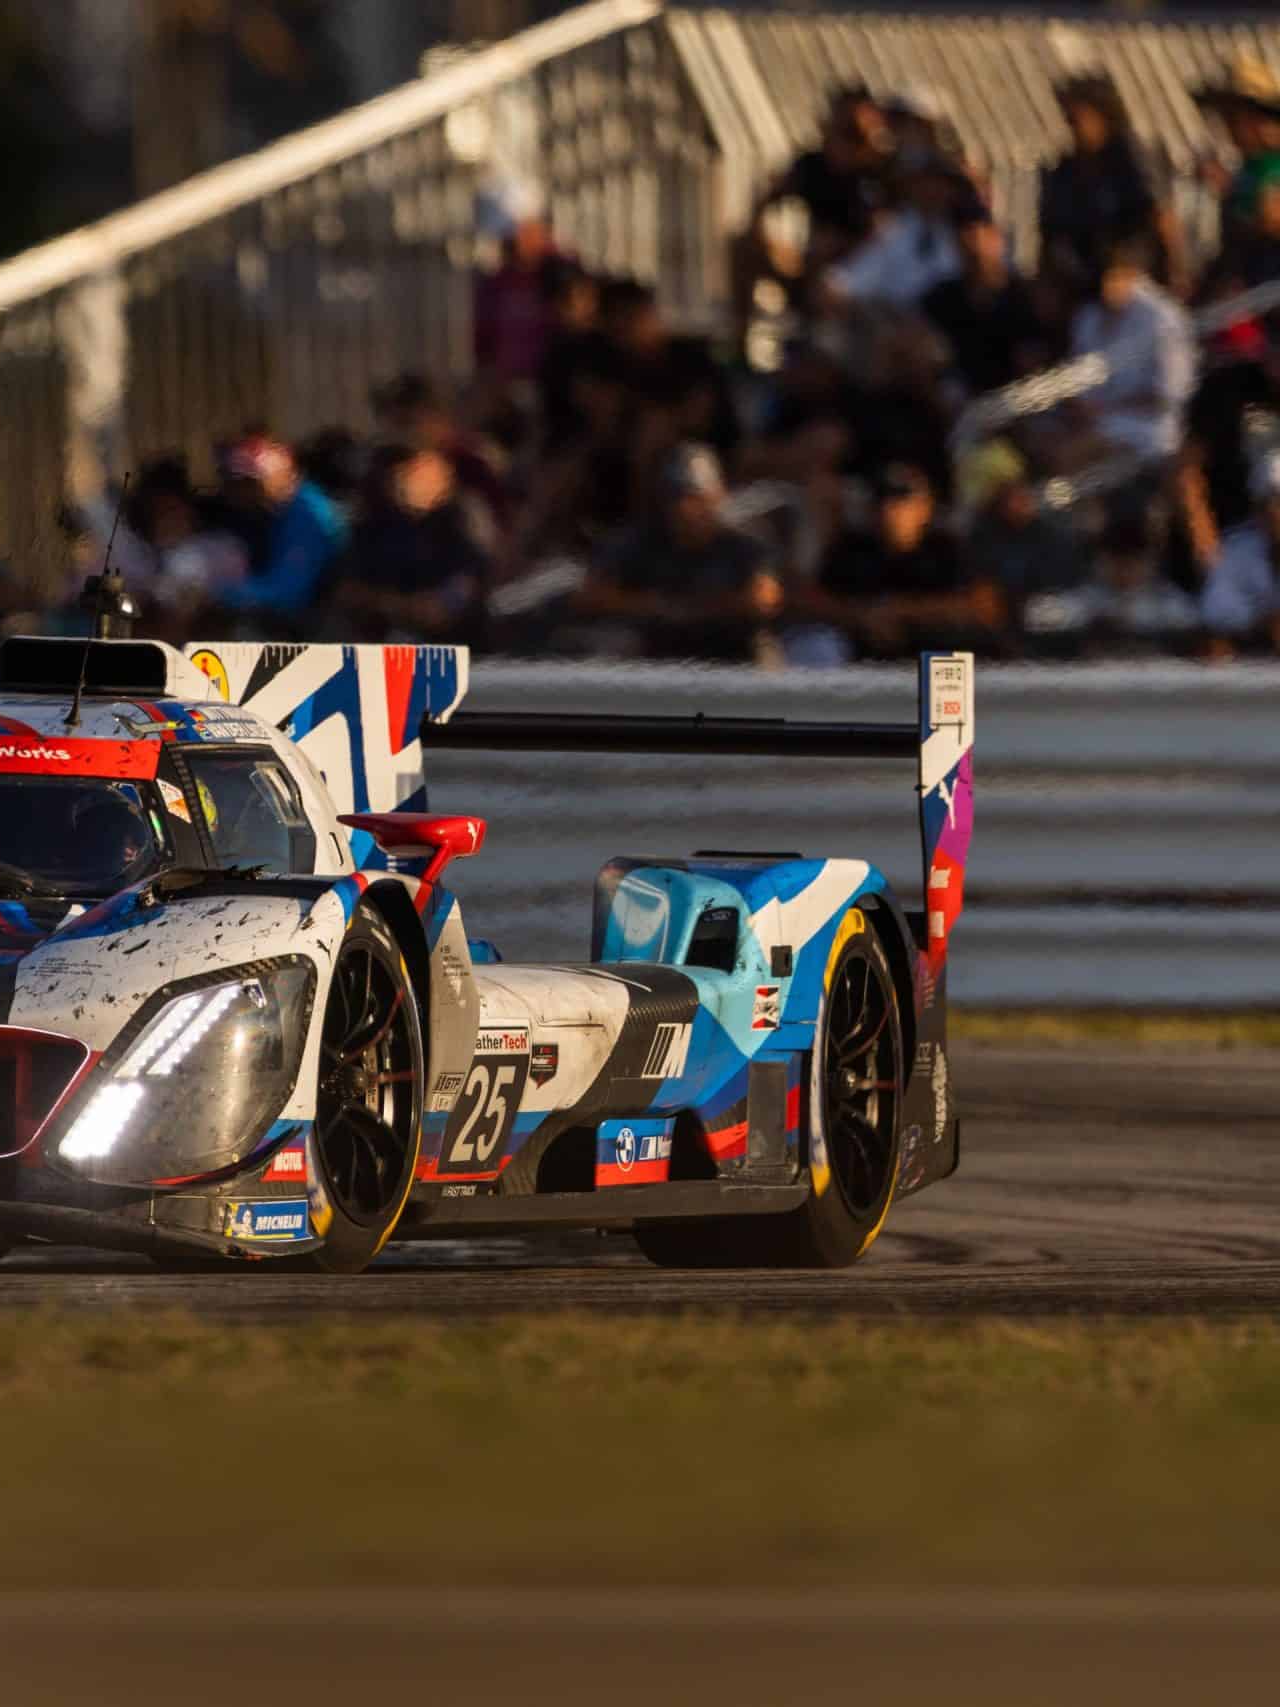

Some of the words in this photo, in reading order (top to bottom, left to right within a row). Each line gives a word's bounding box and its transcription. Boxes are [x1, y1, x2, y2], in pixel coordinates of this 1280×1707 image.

[475, 1033, 528, 1049] atherTech
[448, 1065, 516, 1161] 25
[273, 1151, 303, 1171] MOTUL
[255, 1215, 303, 1230] MICHELIN
